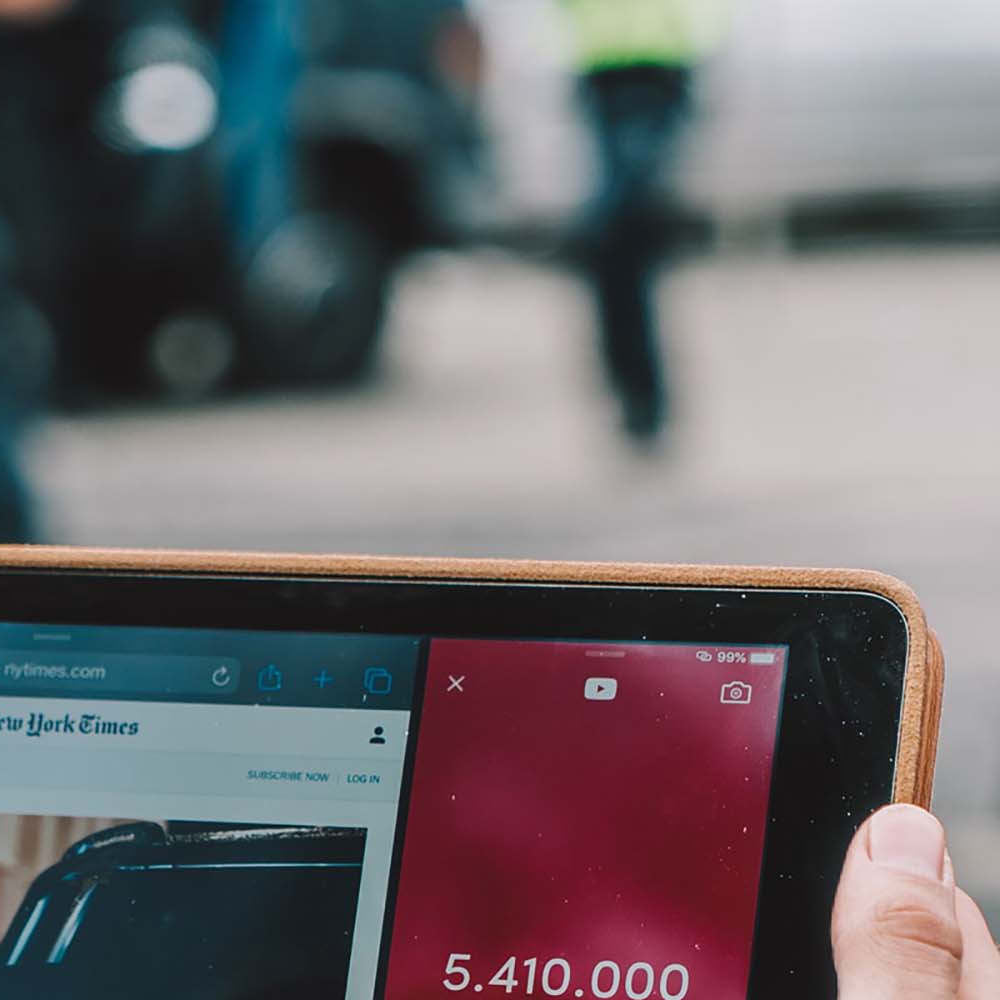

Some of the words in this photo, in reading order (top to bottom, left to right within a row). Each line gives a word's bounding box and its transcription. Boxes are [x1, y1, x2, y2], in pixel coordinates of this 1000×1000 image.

[717, 651, 746, 664] 99%
[4, 662, 106, 680] nytimes.com
[26, 713, 75, 736] York
[79, 714, 139, 735] Times
[247, 770, 303, 782] SUBSCRIBE
[305, 772, 330, 783] NOW
[347, 773, 367, 784] LOG
[369, 774, 381, 785] IN
